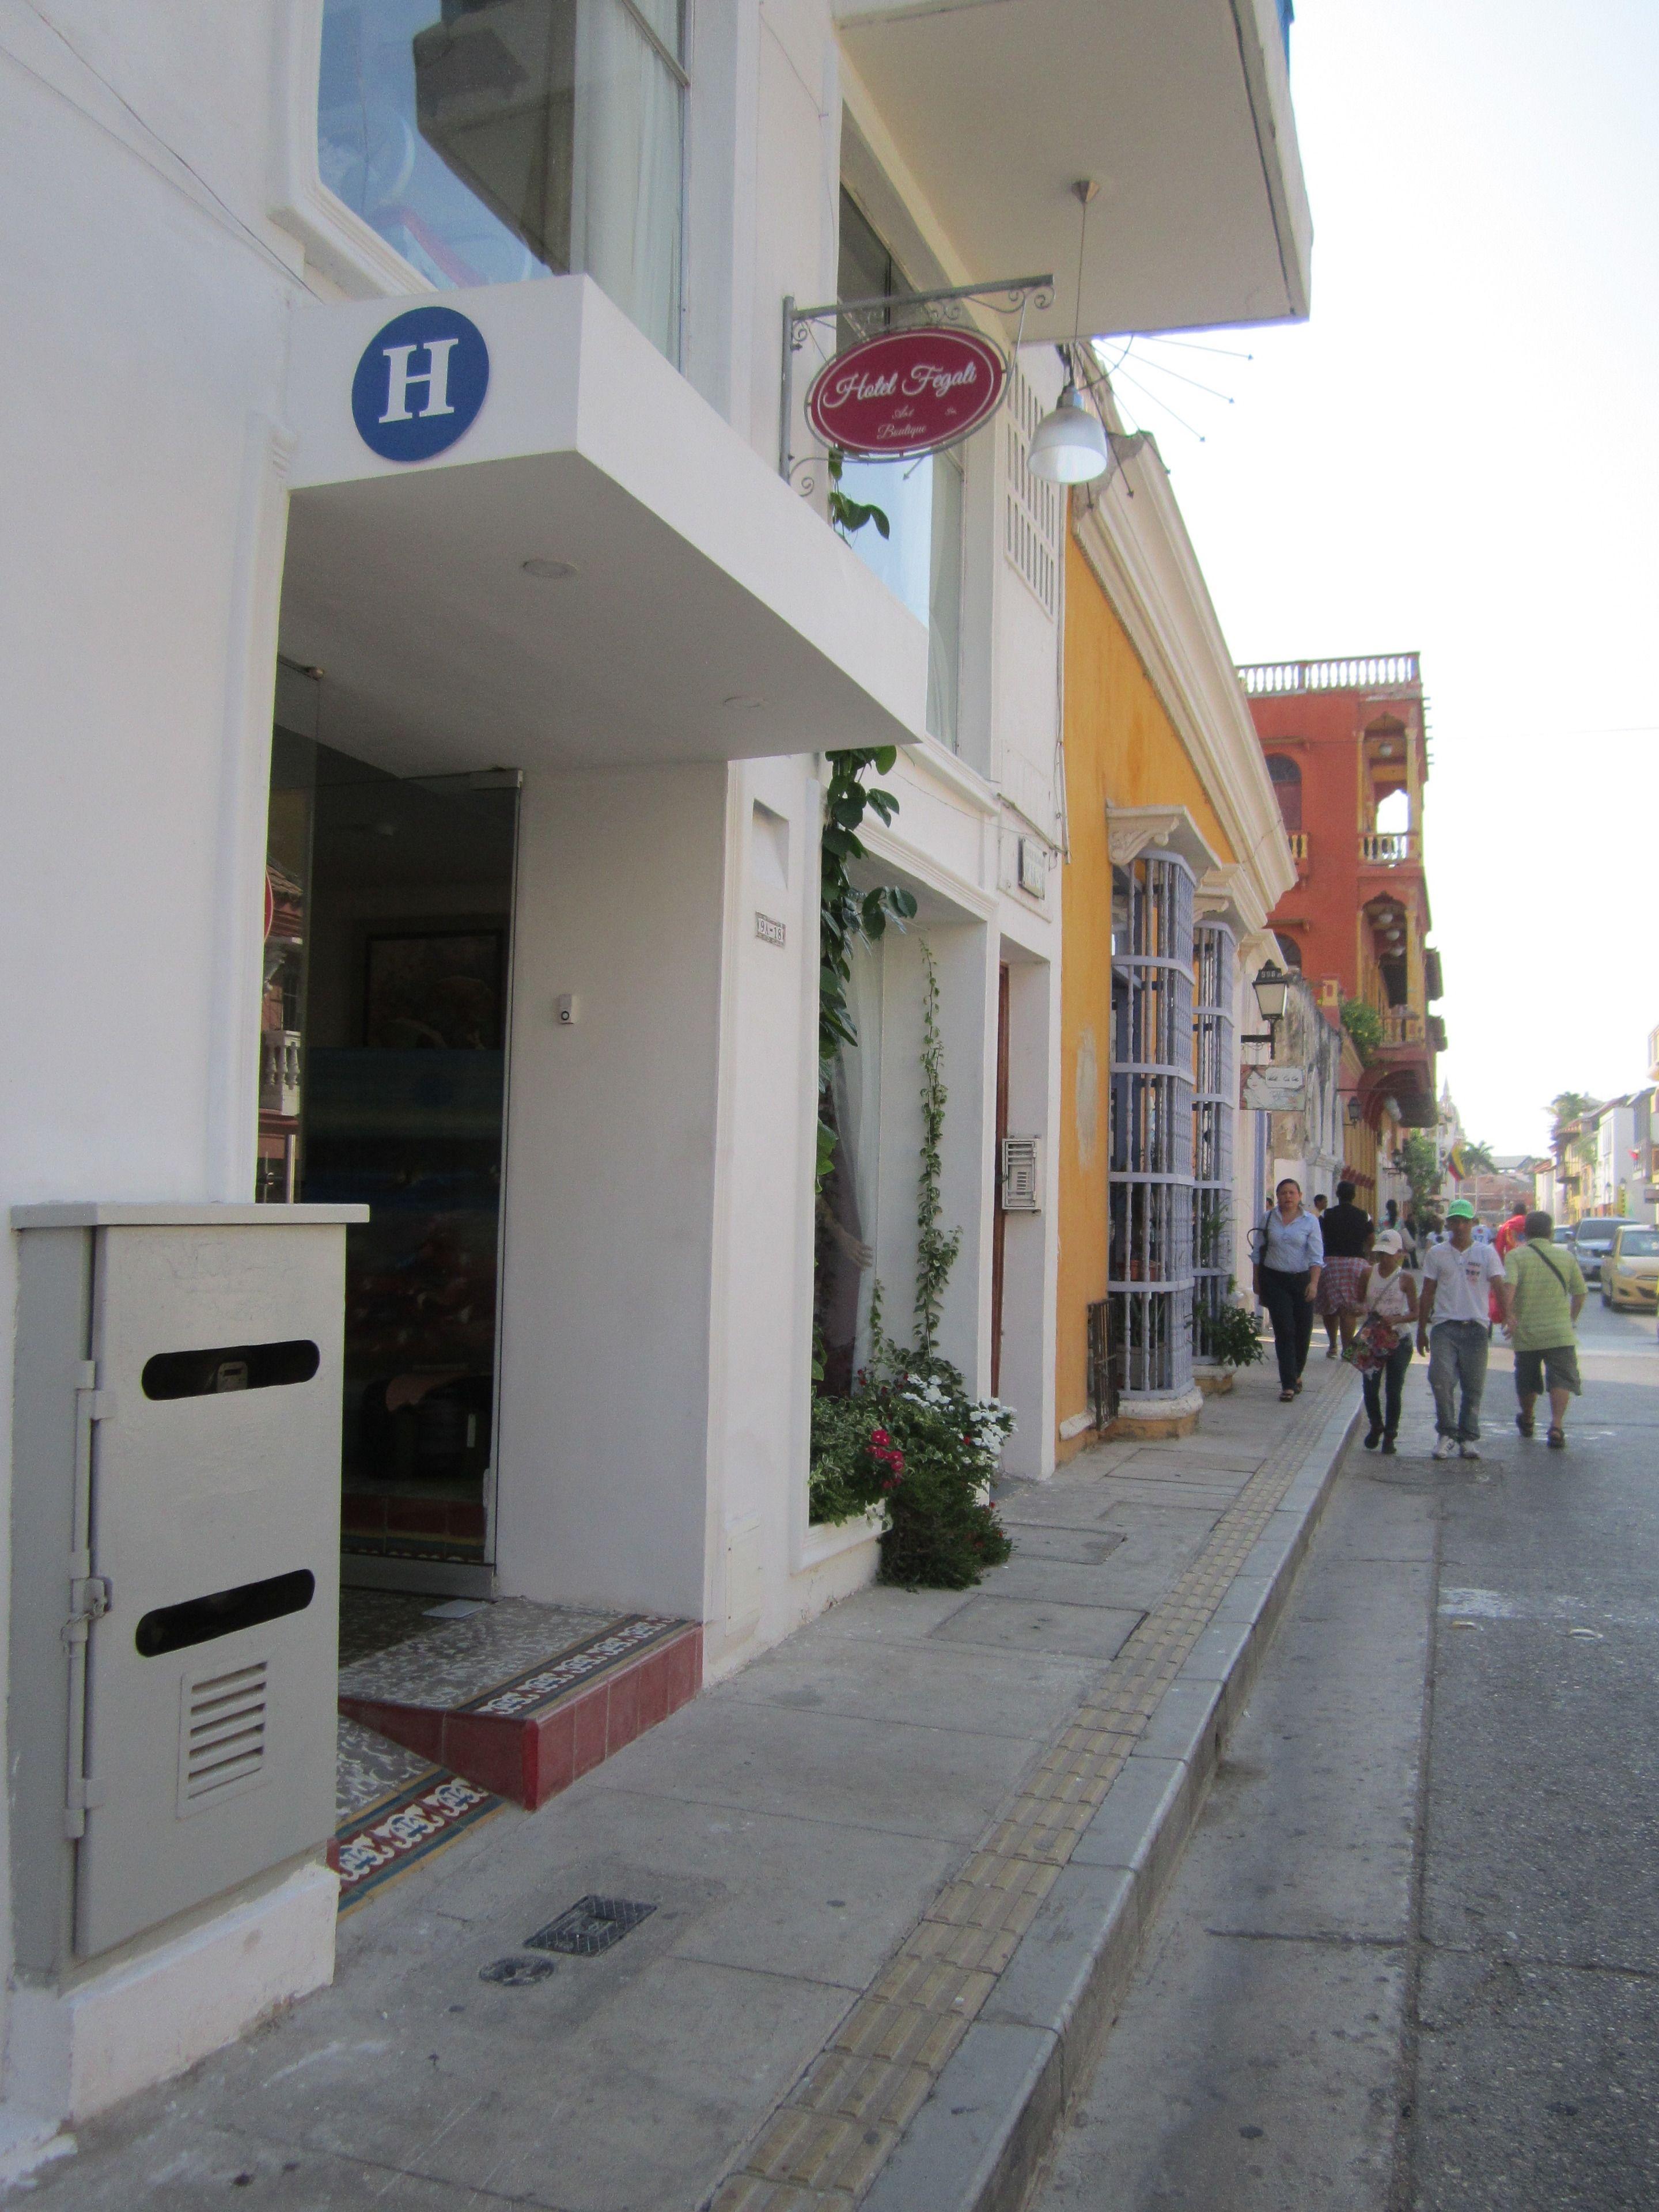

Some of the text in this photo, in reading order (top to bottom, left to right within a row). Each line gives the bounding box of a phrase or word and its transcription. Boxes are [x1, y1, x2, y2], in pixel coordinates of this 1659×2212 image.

[378, 338, 459, 423] H
[823, 361, 978, 408] Hotel Fegali
[892, 404, 915, 420] Art
[877, 423, 927, 440] Boutique
